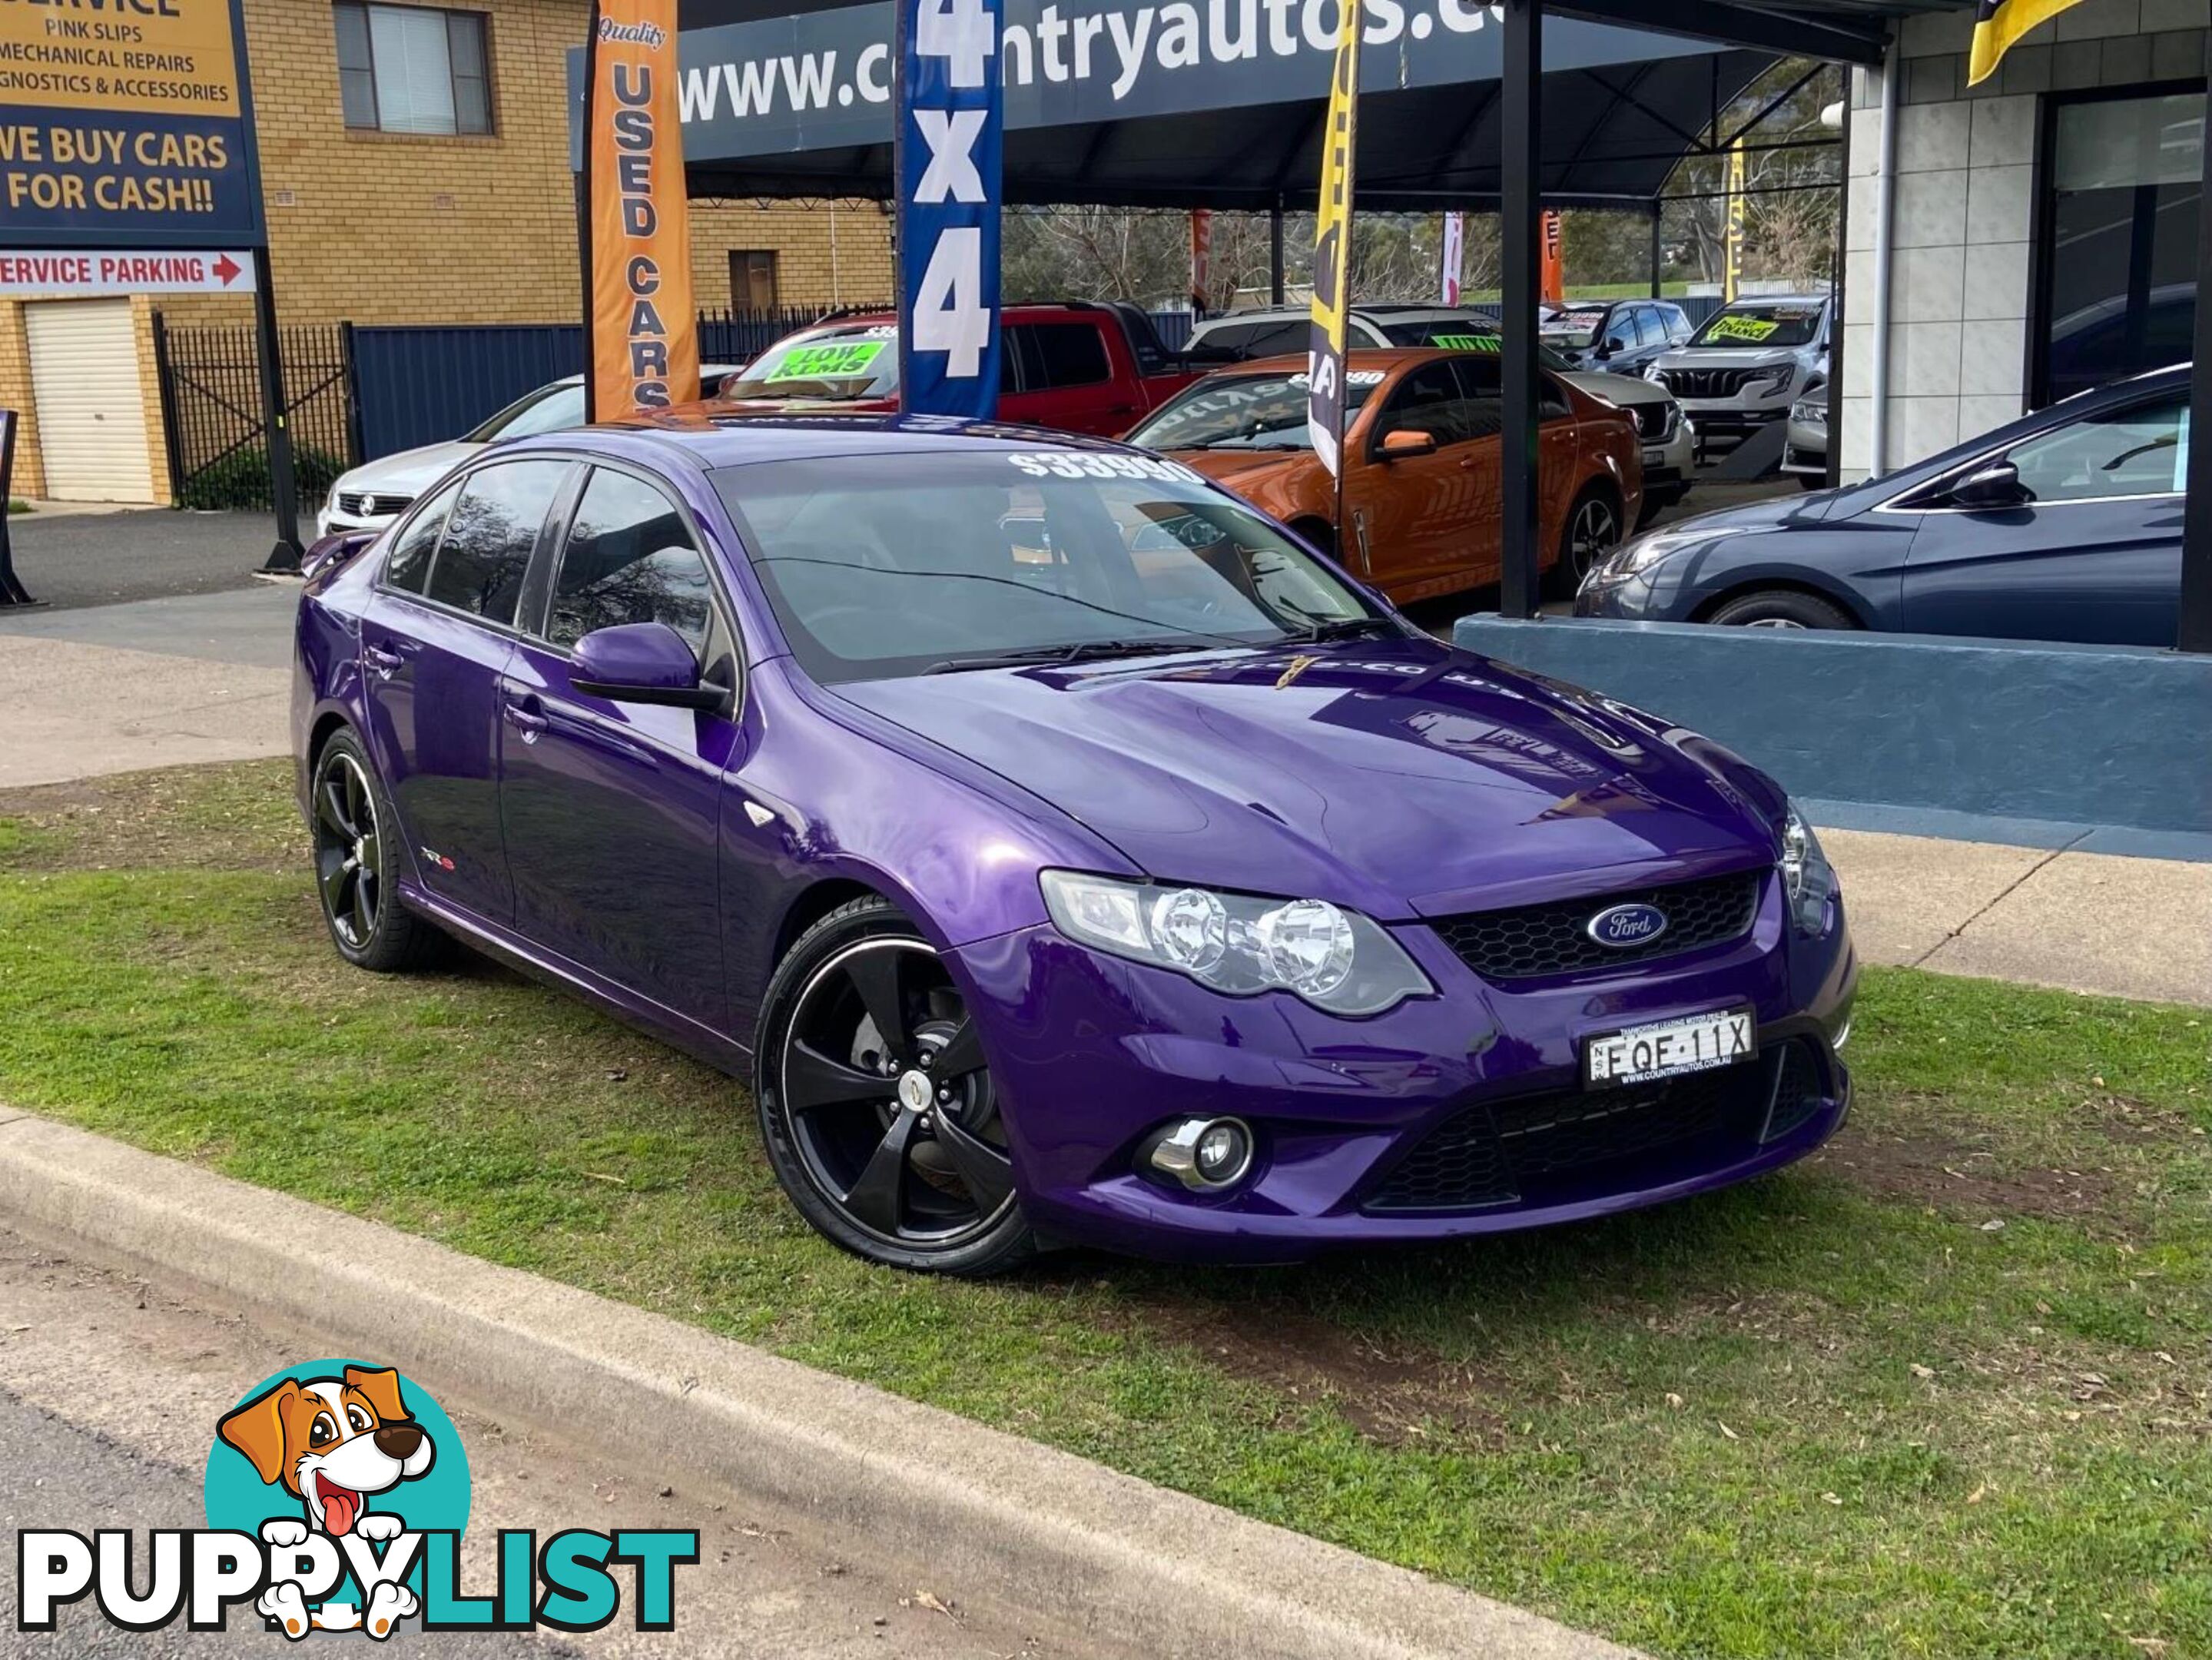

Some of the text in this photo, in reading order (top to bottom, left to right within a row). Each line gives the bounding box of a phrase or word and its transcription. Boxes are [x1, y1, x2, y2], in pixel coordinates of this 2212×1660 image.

[45, 18, 143, 43] PINK SLIPS
[599, 17, 665, 50] Quality
[124, 51, 194, 73] REPAIRS
[96, 78, 108, 95] &
[114, 78, 228, 101] ACCESSORIES
[50, 127, 126, 165] BUY
[134, 131, 227, 169] CARS
[612, 61, 658, 239] USED
[8, 171, 214, 213] FOR CASH!!
[101, 257, 204, 283] PARKING
[626, 254, 673, 407] CARS
[798, 345, 867, 363] LOW
[1007, 453, 1207, 486] $33990
[1609, 912, 1652, 938] Ford
